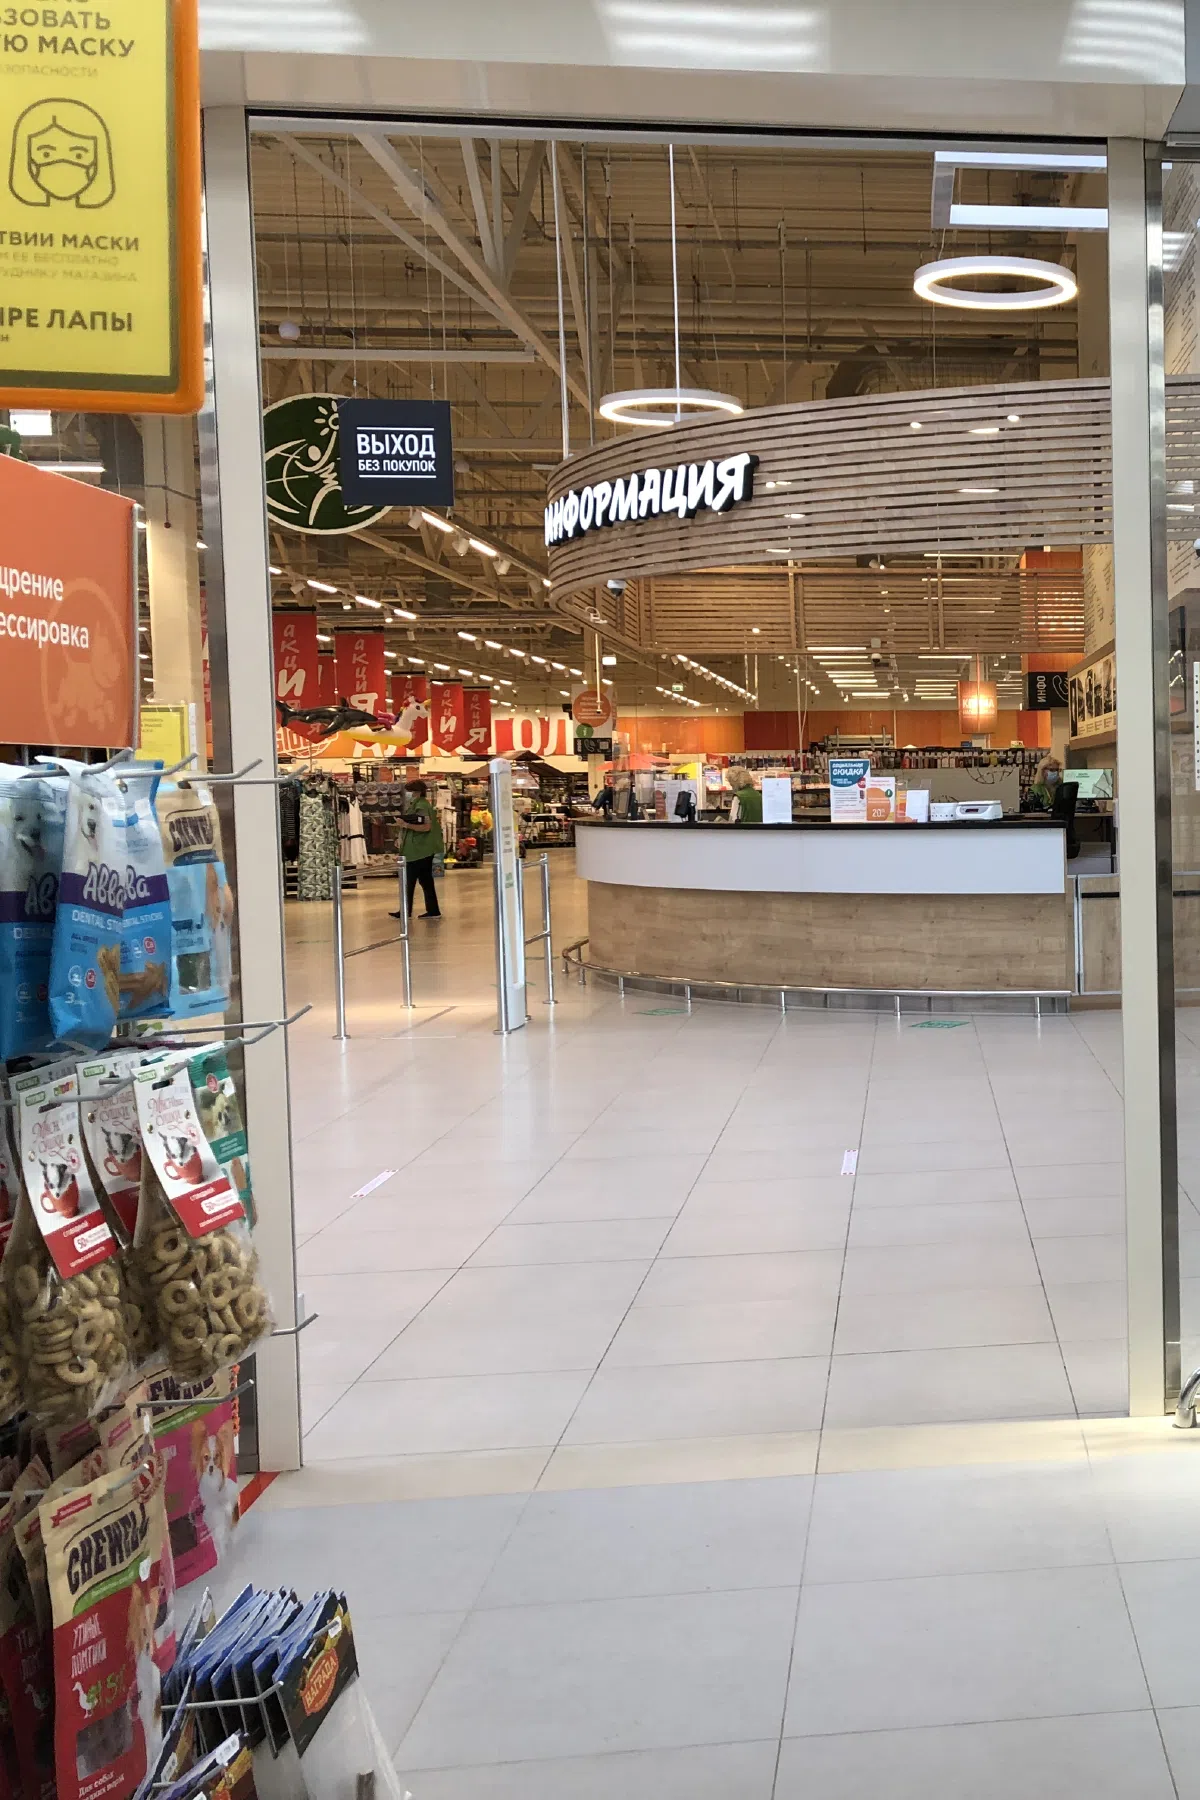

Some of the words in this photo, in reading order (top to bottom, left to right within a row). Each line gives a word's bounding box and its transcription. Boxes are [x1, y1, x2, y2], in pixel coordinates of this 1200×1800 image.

[0, 8, 112, 30] ЗОВАТЬ
[0, 33, 29, 53] Ю
[38, 34, 136, 58] МАСКУ
[61, 233, 140, 251] МАСКИ
[46, 308, 134, 332] ЛАПЫ
[356, 432, 436, 459] ВЫХОД
[358, 459, 380, 471] БЕЗ
[383, 459, 436, 473] ПОКУПОК
[544, 452, 752, 546] ИНФОРМАЦИЯ
[1036, 675, 1046, 703] ИНФО
[71, 909, 105, 929] DENTAL
[305, 1656, 337, 1709] НАГРАДА
